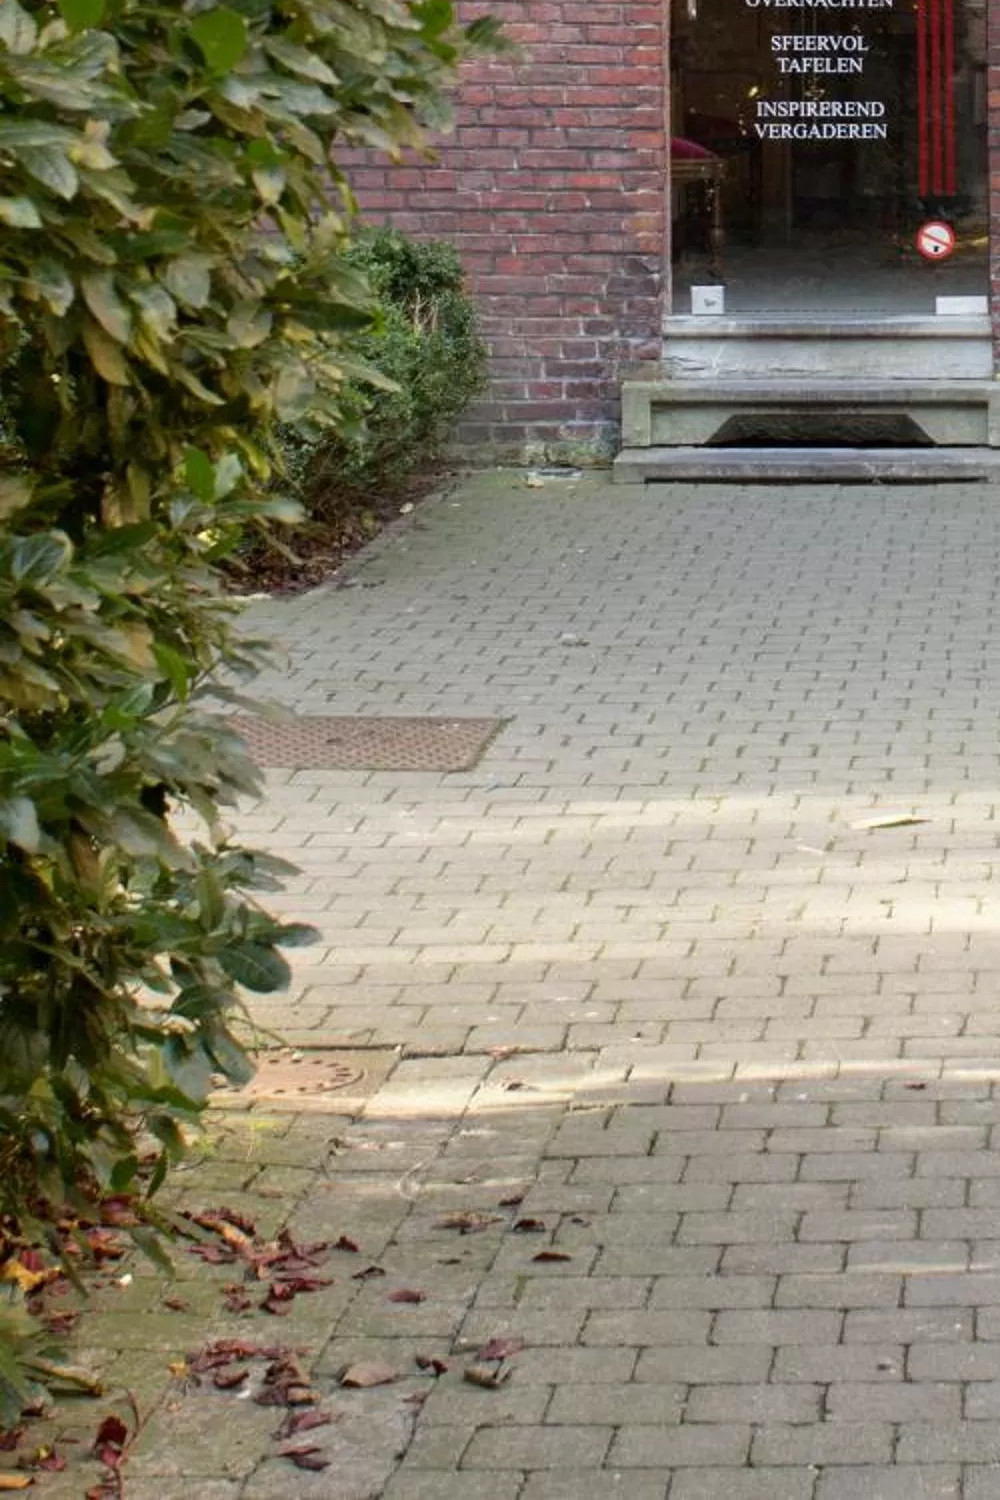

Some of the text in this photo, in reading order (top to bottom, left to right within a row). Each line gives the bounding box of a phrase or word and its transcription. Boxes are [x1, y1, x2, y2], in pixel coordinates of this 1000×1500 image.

[771, 35, 869, 51] SFEERVOL
[777, 57, 863, 73] TAFELEN
[757, 101, 885, 117] INSPIREREND
[754, 123, 888, 139] VERGADEREN
